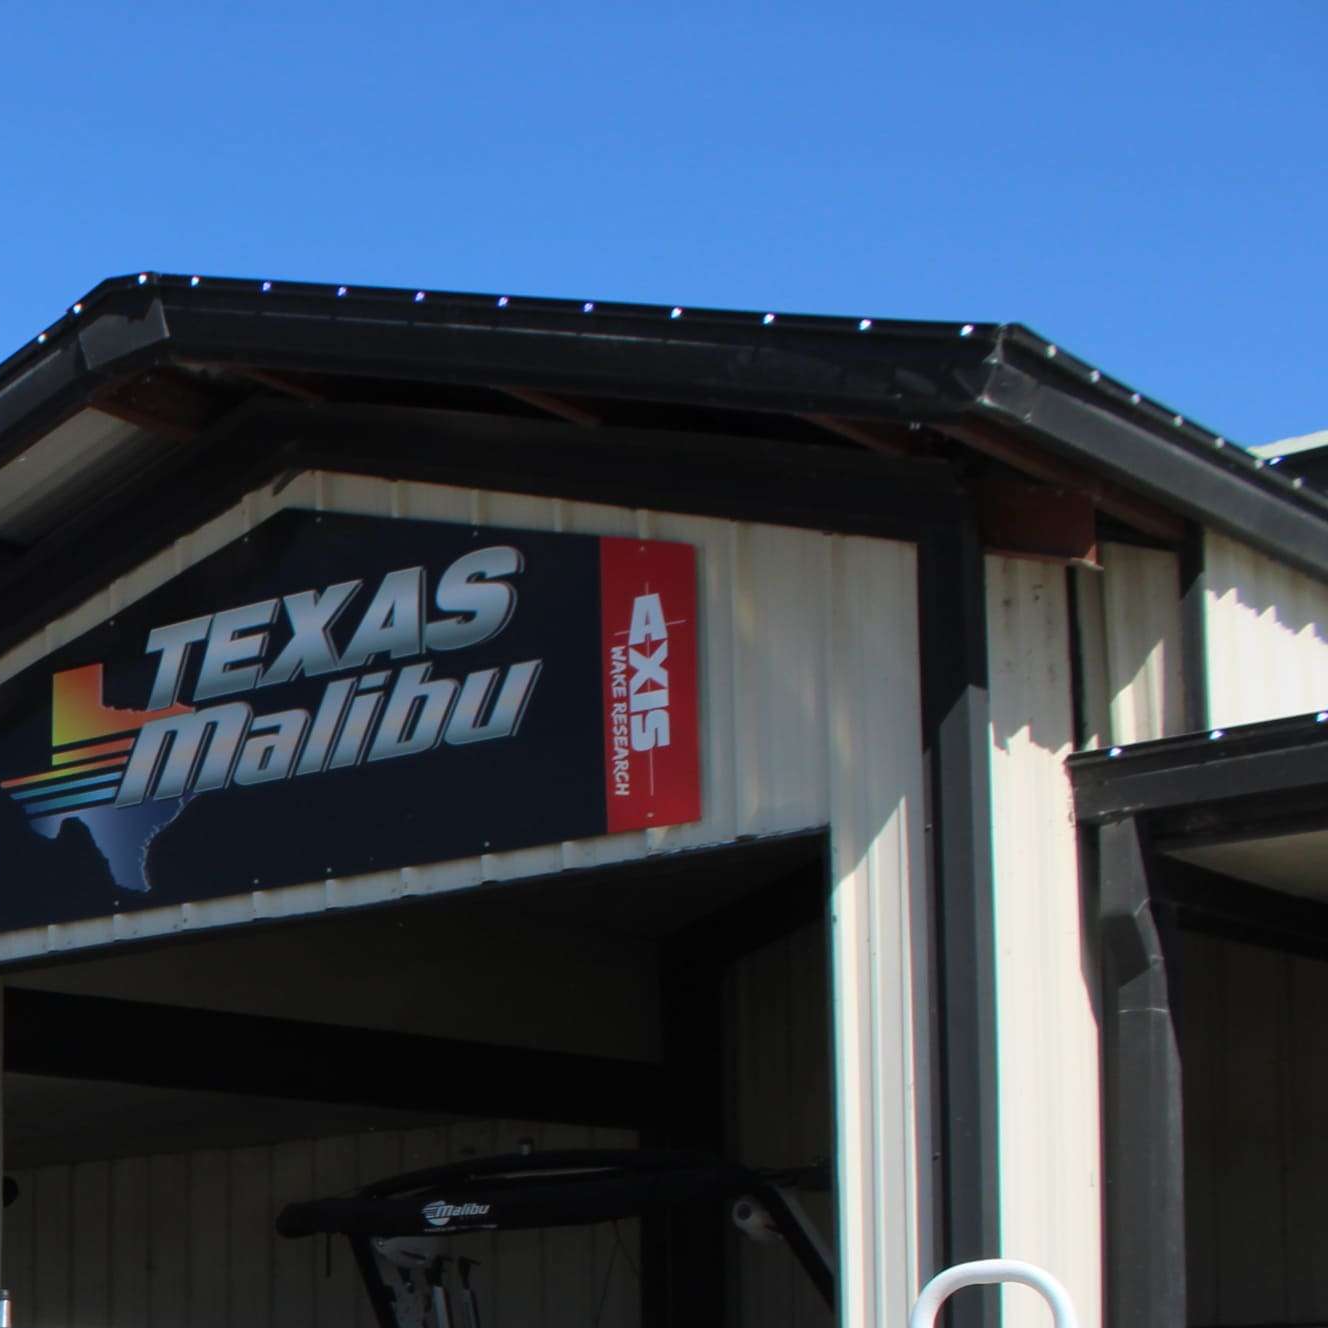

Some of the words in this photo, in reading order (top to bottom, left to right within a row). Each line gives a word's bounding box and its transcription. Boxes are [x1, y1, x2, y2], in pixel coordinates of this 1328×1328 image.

[145, 545, 525, 713] TEXAS
[610, 646, 628, 698] WAKE
[628, 593, 670, 752] AXIS
[115, 658, 544, 808] Malibu
[612, 703, 630, 796] RESEARCH
[435, 1203, 490, 1218] Malibu
